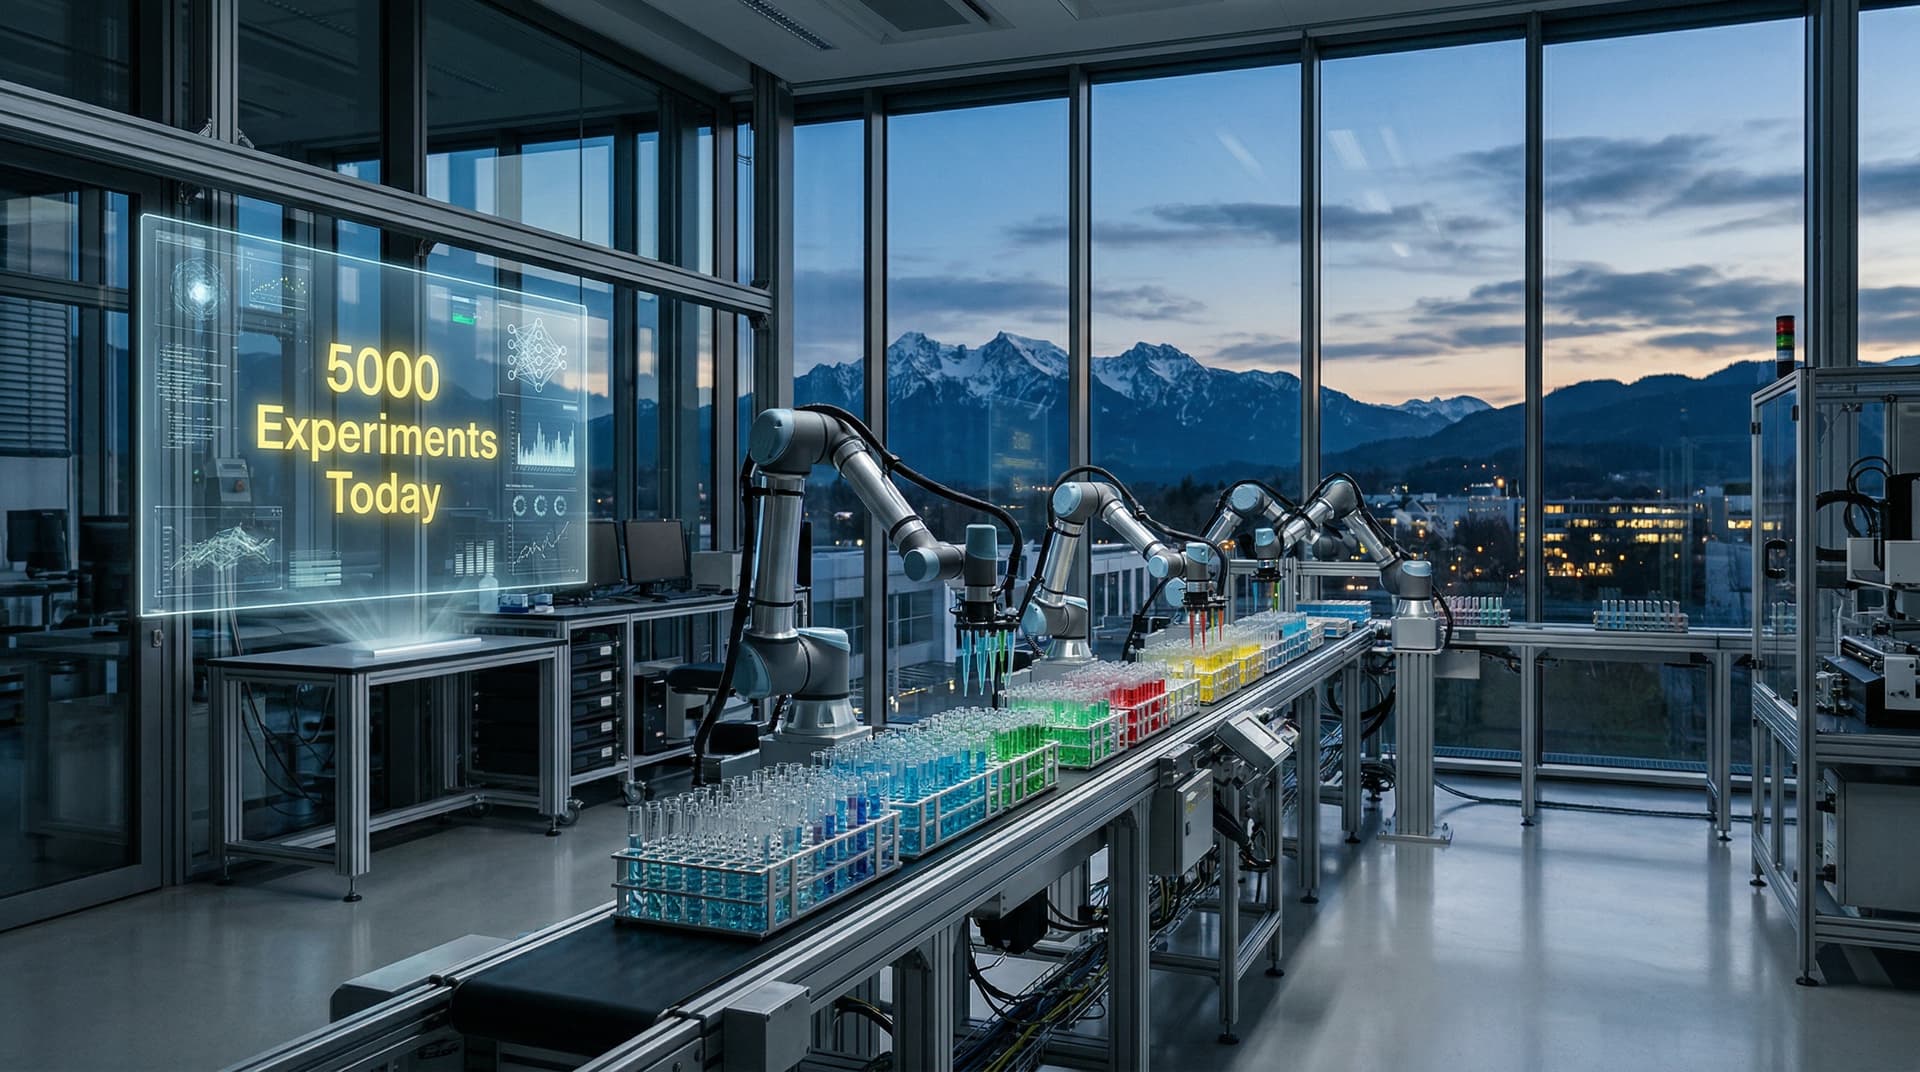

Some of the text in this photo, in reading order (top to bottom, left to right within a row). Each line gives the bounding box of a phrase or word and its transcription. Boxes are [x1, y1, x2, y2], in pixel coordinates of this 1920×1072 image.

[327, 343, 439, 401] 5000
[257, 404, 498, 462] Experiments
[326, 470, 442, 524] Today
